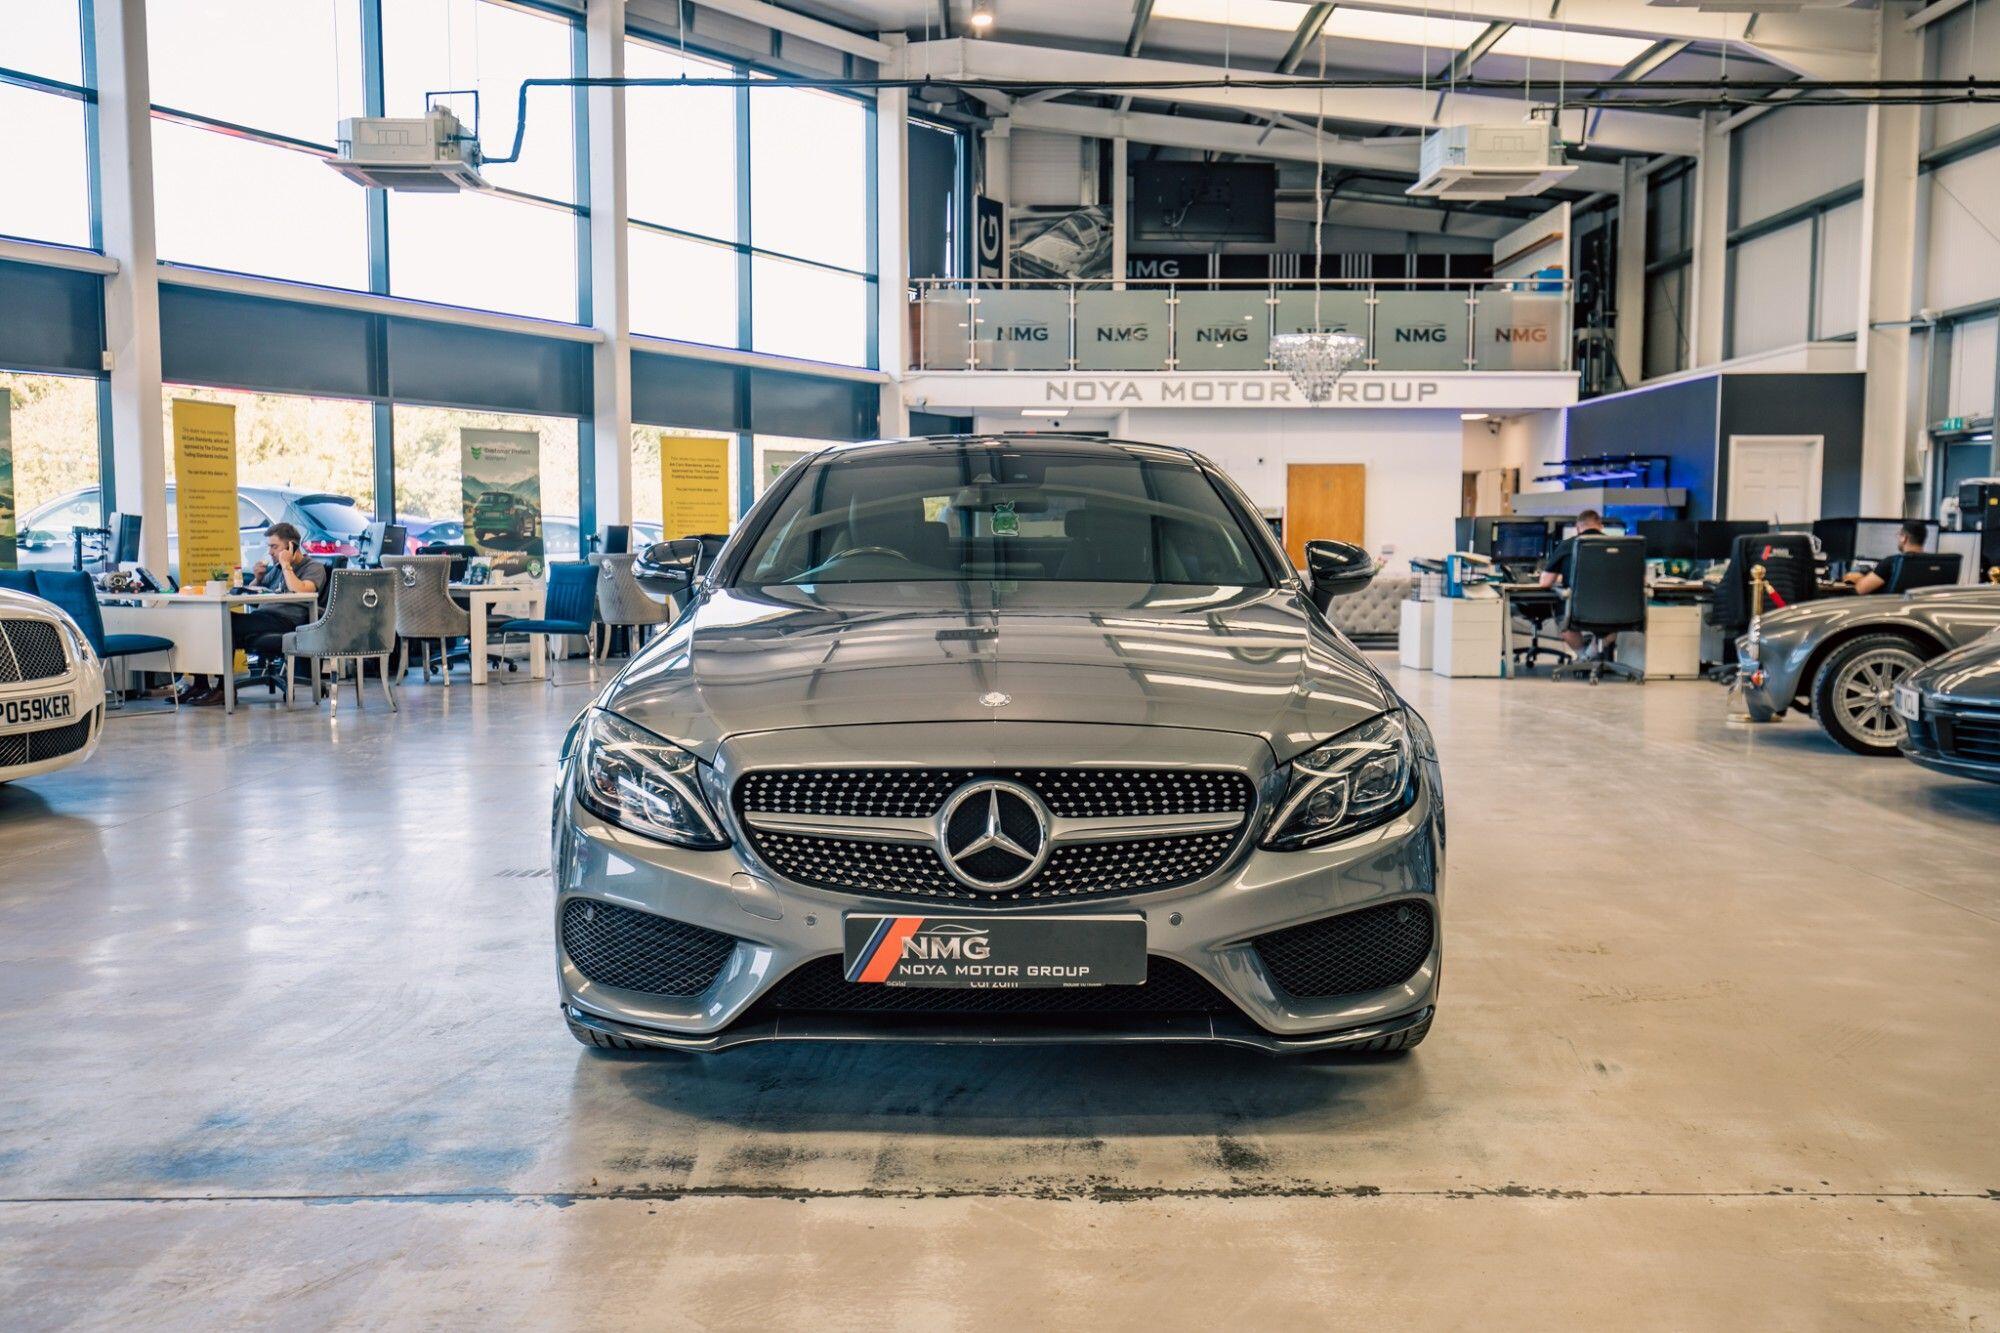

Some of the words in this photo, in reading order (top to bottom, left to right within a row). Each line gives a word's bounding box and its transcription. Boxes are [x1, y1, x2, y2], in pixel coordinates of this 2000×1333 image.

[997, 327, 1048, 341] NMG
[1097, 327, 1148, 342] NMG
[1197, 327, 1248, 342] NMG
[1395, 327, 1447, 342] NMG
[1496, 327, 1547, 342] NMG
[1046, 381, 1143, 401] NOYA
[1161, 381, 1291, 401] MOTOR
[901, 936, 991, 960] NMG
[900, 965, 947, 976] NOYA
[955, 965, 1019, 976] MOTOR
[1027, 966, 1090, 977] GROUP
